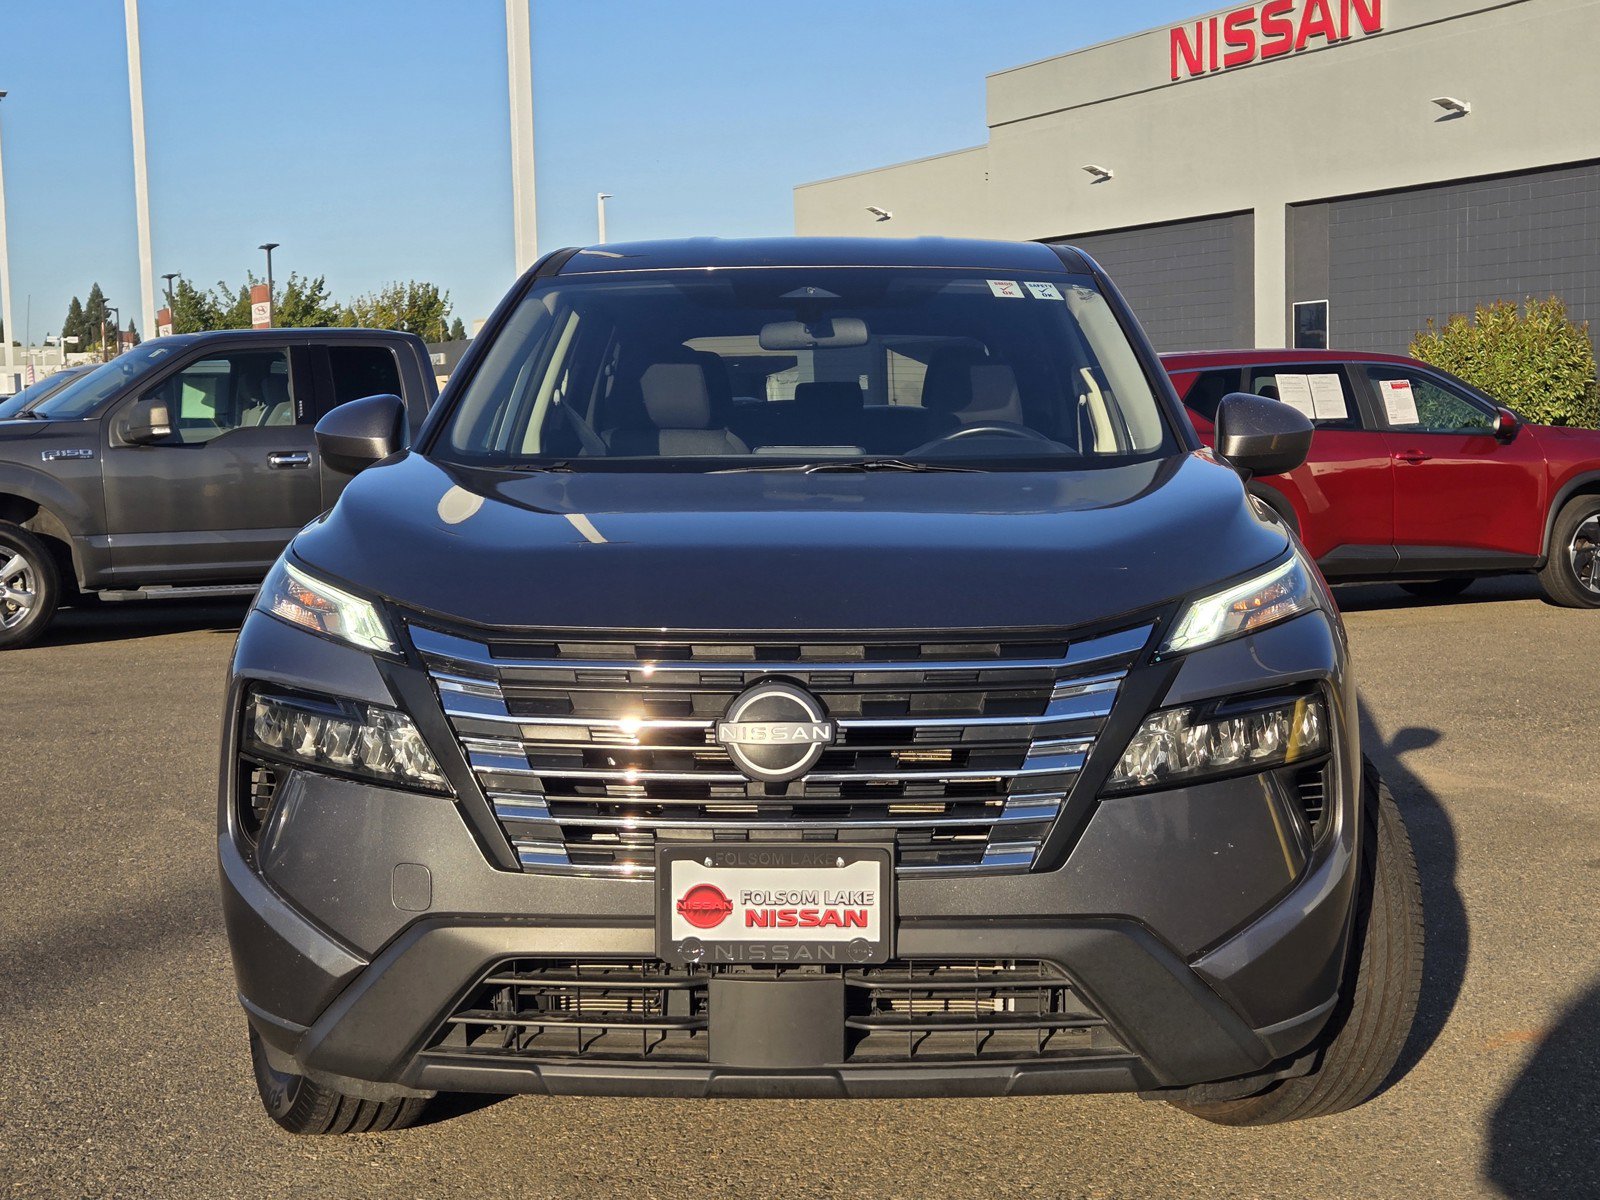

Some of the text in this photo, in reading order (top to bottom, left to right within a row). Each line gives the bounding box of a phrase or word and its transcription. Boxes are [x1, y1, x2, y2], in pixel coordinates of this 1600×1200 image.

[1170, 0, 1383, 81] NISSAN
[721, 725, 831, 740] NISSAN
[715, 852, 835, 865] FOLSOM LAKE
[740, 889, 875, 905] FOLSOM LAKE
[676, 901, 734, 910] NISSAN
[745, 908, 868, 928] NISSAN
[714, 944, 836, 960] NISSAN
